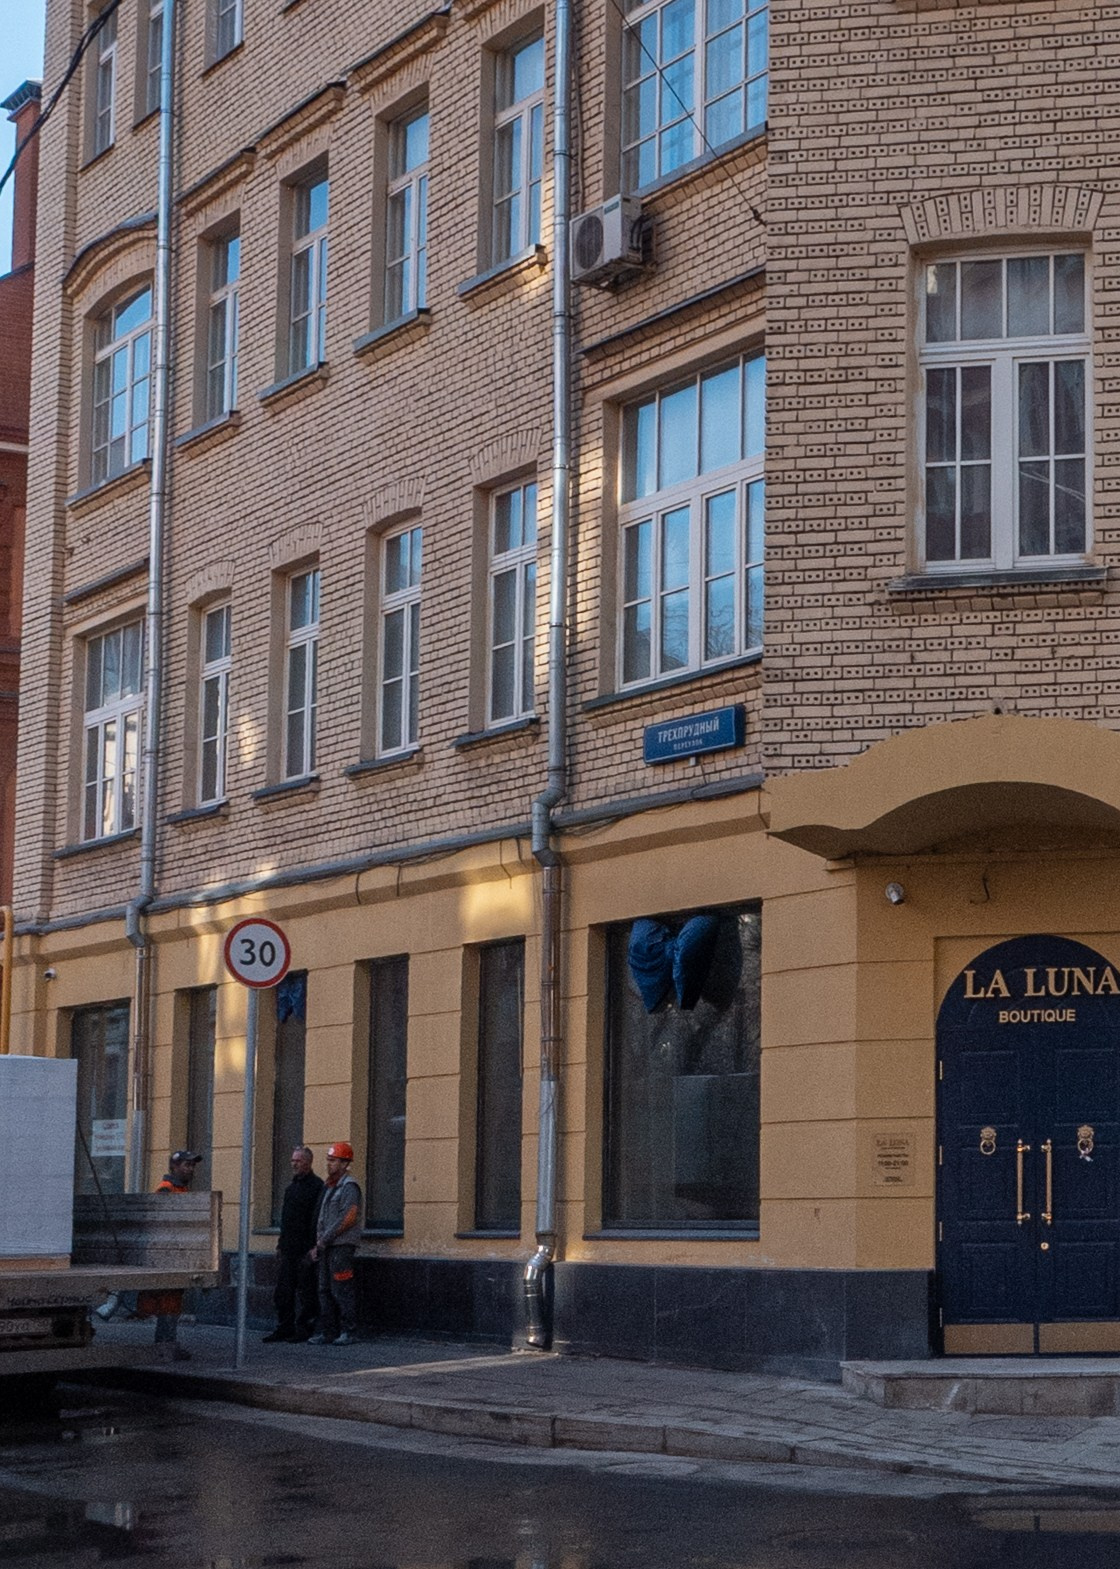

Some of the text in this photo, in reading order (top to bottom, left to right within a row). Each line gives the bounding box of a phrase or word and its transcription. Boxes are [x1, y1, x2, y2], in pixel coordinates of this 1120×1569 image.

[658, 716, 720, 744] ТРЕХПРУДНЫЙ
[673, 738, 703, 751] ПЕРЕУЛОК
[239, 938, 276, 968] 30
[963, 966, 1120, 998] LA LUNA
[999, 1009, 1076, 1024] BOUTIQUE
